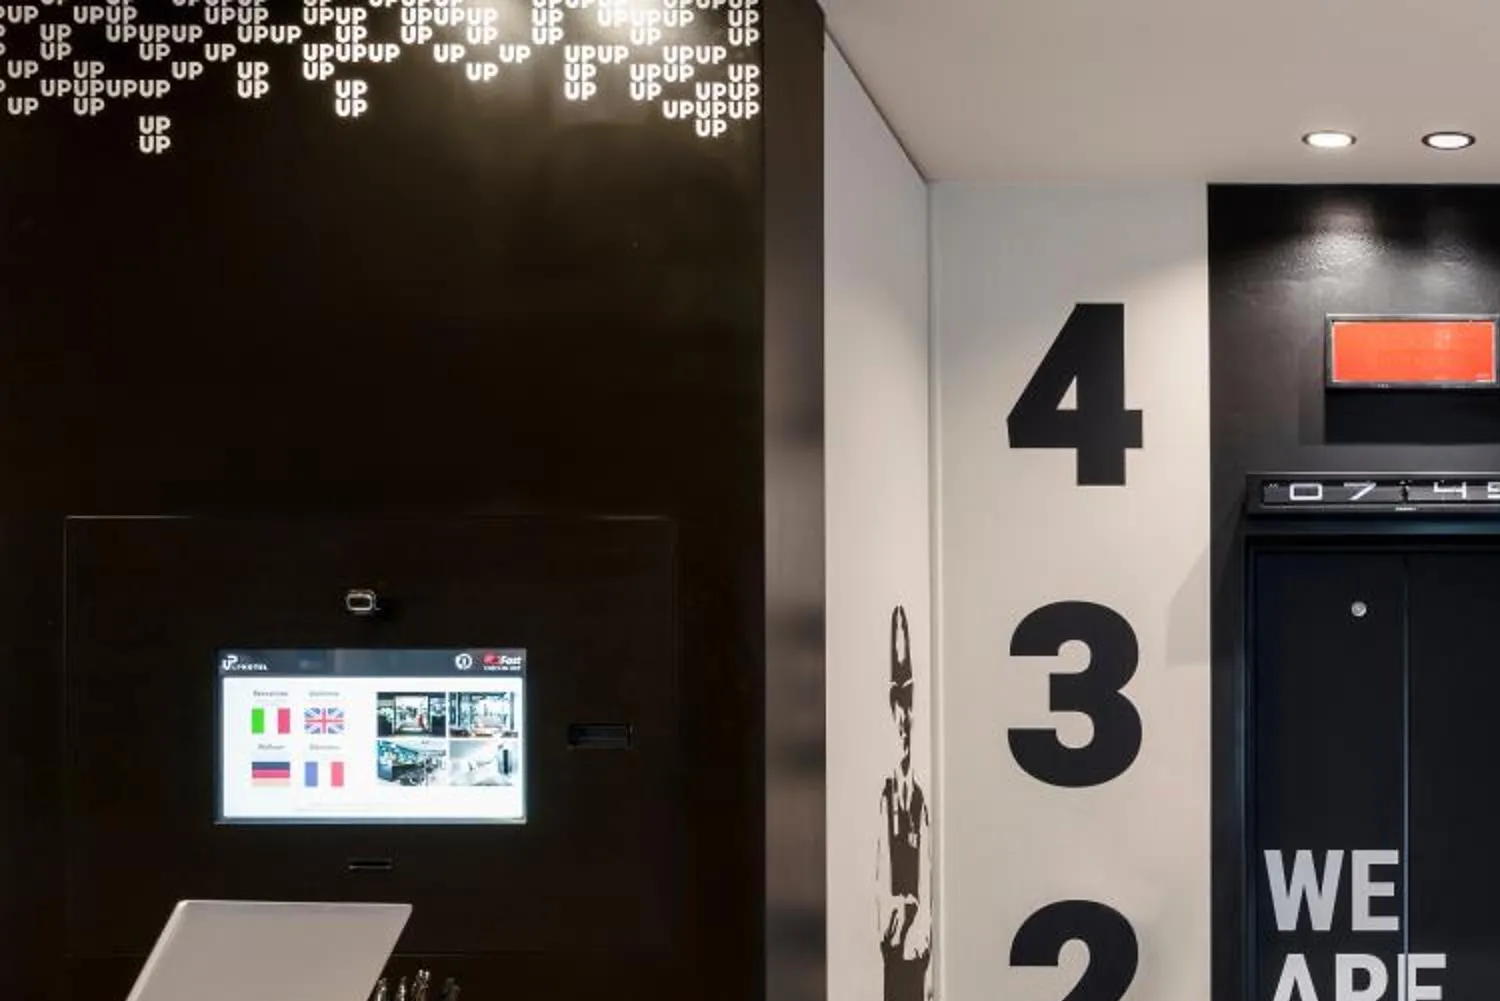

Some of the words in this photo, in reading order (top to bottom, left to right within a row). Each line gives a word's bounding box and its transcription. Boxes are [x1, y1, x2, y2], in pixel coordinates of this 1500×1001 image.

[8, 6, 39, 23] UP
[73, 6, 104, 23] UP
[106, 6, 137, 24] UP
[204, 7, 236, 24] UP
[237, 7, 268, 24] UP
[303, 7, 334, 25] UP
[336, 7, 367, 25] UP
[402, 8, 433, 25] UP
[434, 8, 465, 26] UP
[466, 8, 498, 26] UP
[532, 9, 564, 26] UP
[663, 9, 694, 27] UP
[729, 10, 760, 27] UP
[40, 24, 72, 42] UP
[106, 25, 137, 42] UP
[138, 25, 170, 42] UP
[172, 25, 203, 42] UP
[237, 25, 268, 43] UP
[270, 25, 302, 43] UP
[336, 26, 367, 43] UP
[402, 26, 433, 44] UP
[466, 27, 498, 44] UP
[532, 27, 564, 44] UP
[630, 28, 662, 45] UP
[729, 28, 760, 46] UP
[40, 43, 72, 60] UP
[138, 43, 170, 61] UP
[204, 43, 236, 61] UP
[303, 44, 334, 62] UP
[336, 44, 367, 62] UP
[368, 44, 400, 62] UP
[434, 45, 465, 62] UP
[499, 45, 530, 63] UP
[564, 46, 596, 63] UP
[598, 46, 629, 63] UP
[663, 46, 694, 64] UP
[696, 46, 728, 64] UP
[8, 61, 39, 78] UP
[73, 61, 104, 79] UP
[172, 62, 203, 79] UP
[237, 62, 268, 80] UP
[303, 62, 334, 80] UP
[466, 63, 498, 81] UP
[564, 64, 596, 81] UP
[630, 64, 662, 82] UP
[663, 65, 694, 82] UP
[729, 65, 760, 82] UP
[40, 79, 72, 97] UP
[73, 80, 104, 97] UP
[106, 80, 137, 97] UP
[138, 80, 170, 97] UP
[237, 80, 268, 98] UP
[336, 81, 367, 99] UP
[564, 82, 596, 100] UP
[630, 83, 662, 100] UP
[696, 83, 728, 101] UP
[729, 83, 760, 101] UP
[8, 98, 39, 115] UP
[73, 98, 104, 115] UP
[336, 99, 367, 117] UP
[663, 101, 694, 119] UP
[696, 102, 728, 119] UP
[729, 102, 760, 119] UP
[138, 117, 170, 134] UP
[696, 120, 728, 137] UP
[138, 135, 170, 153] UP
[1007, 302, 1143, 486] 4
[1008, 601, 1143, 788] 3
[1264, 849, 1400, 931] WE
